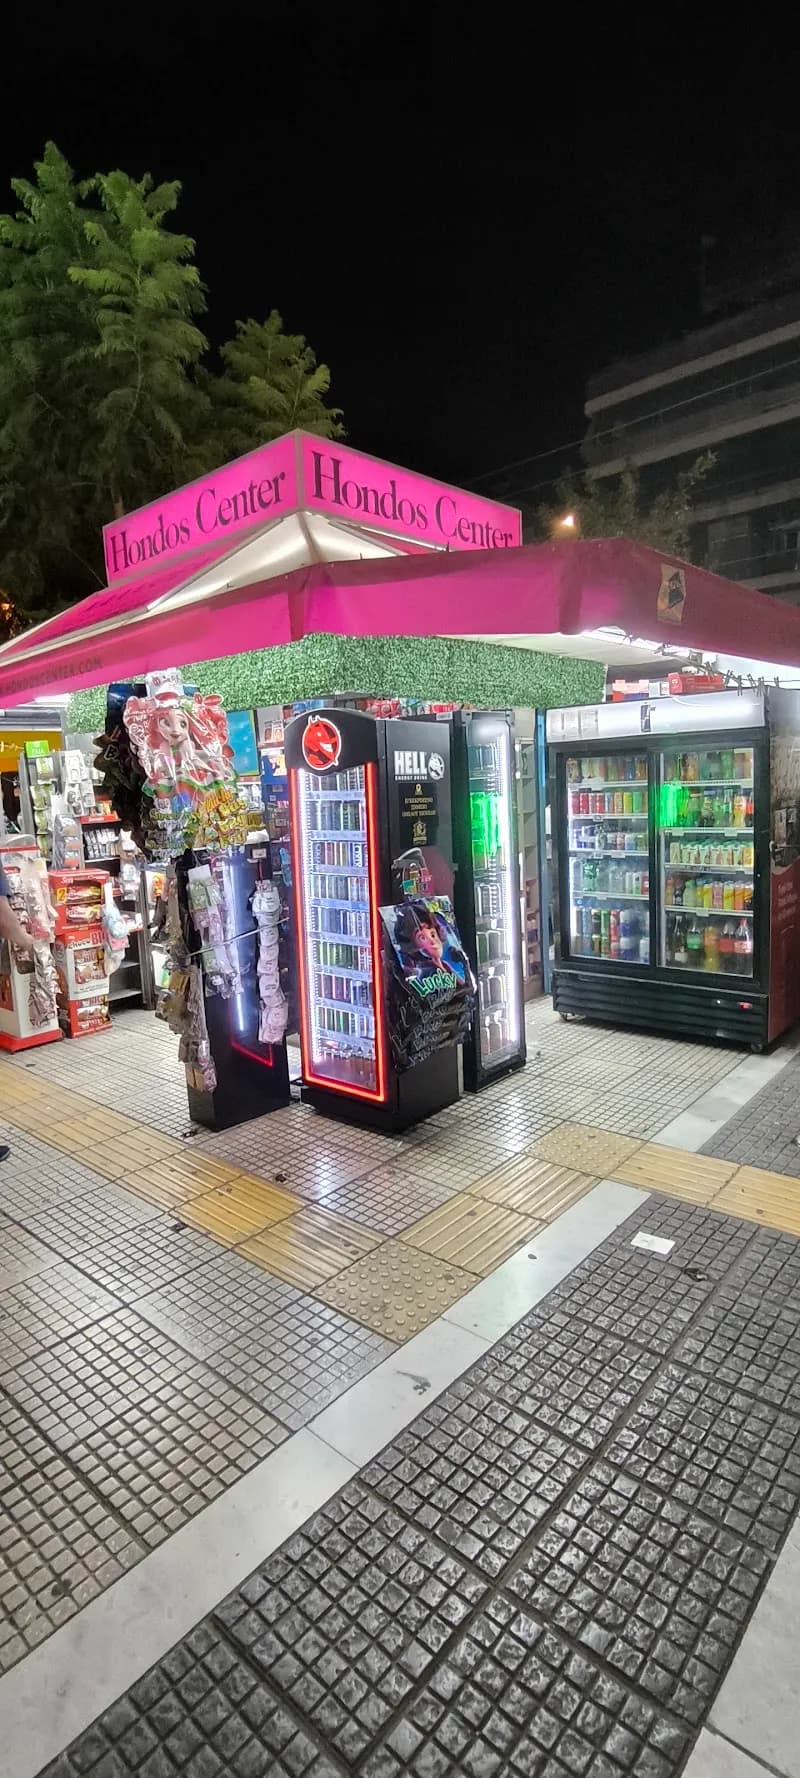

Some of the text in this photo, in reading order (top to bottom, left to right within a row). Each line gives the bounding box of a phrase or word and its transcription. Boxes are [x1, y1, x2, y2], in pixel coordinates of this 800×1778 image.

[109, 472, 286, 574] Hondos Center
[312, 450, 513, 549] Hondos Center
[394, 750, 428, 775] HELL
